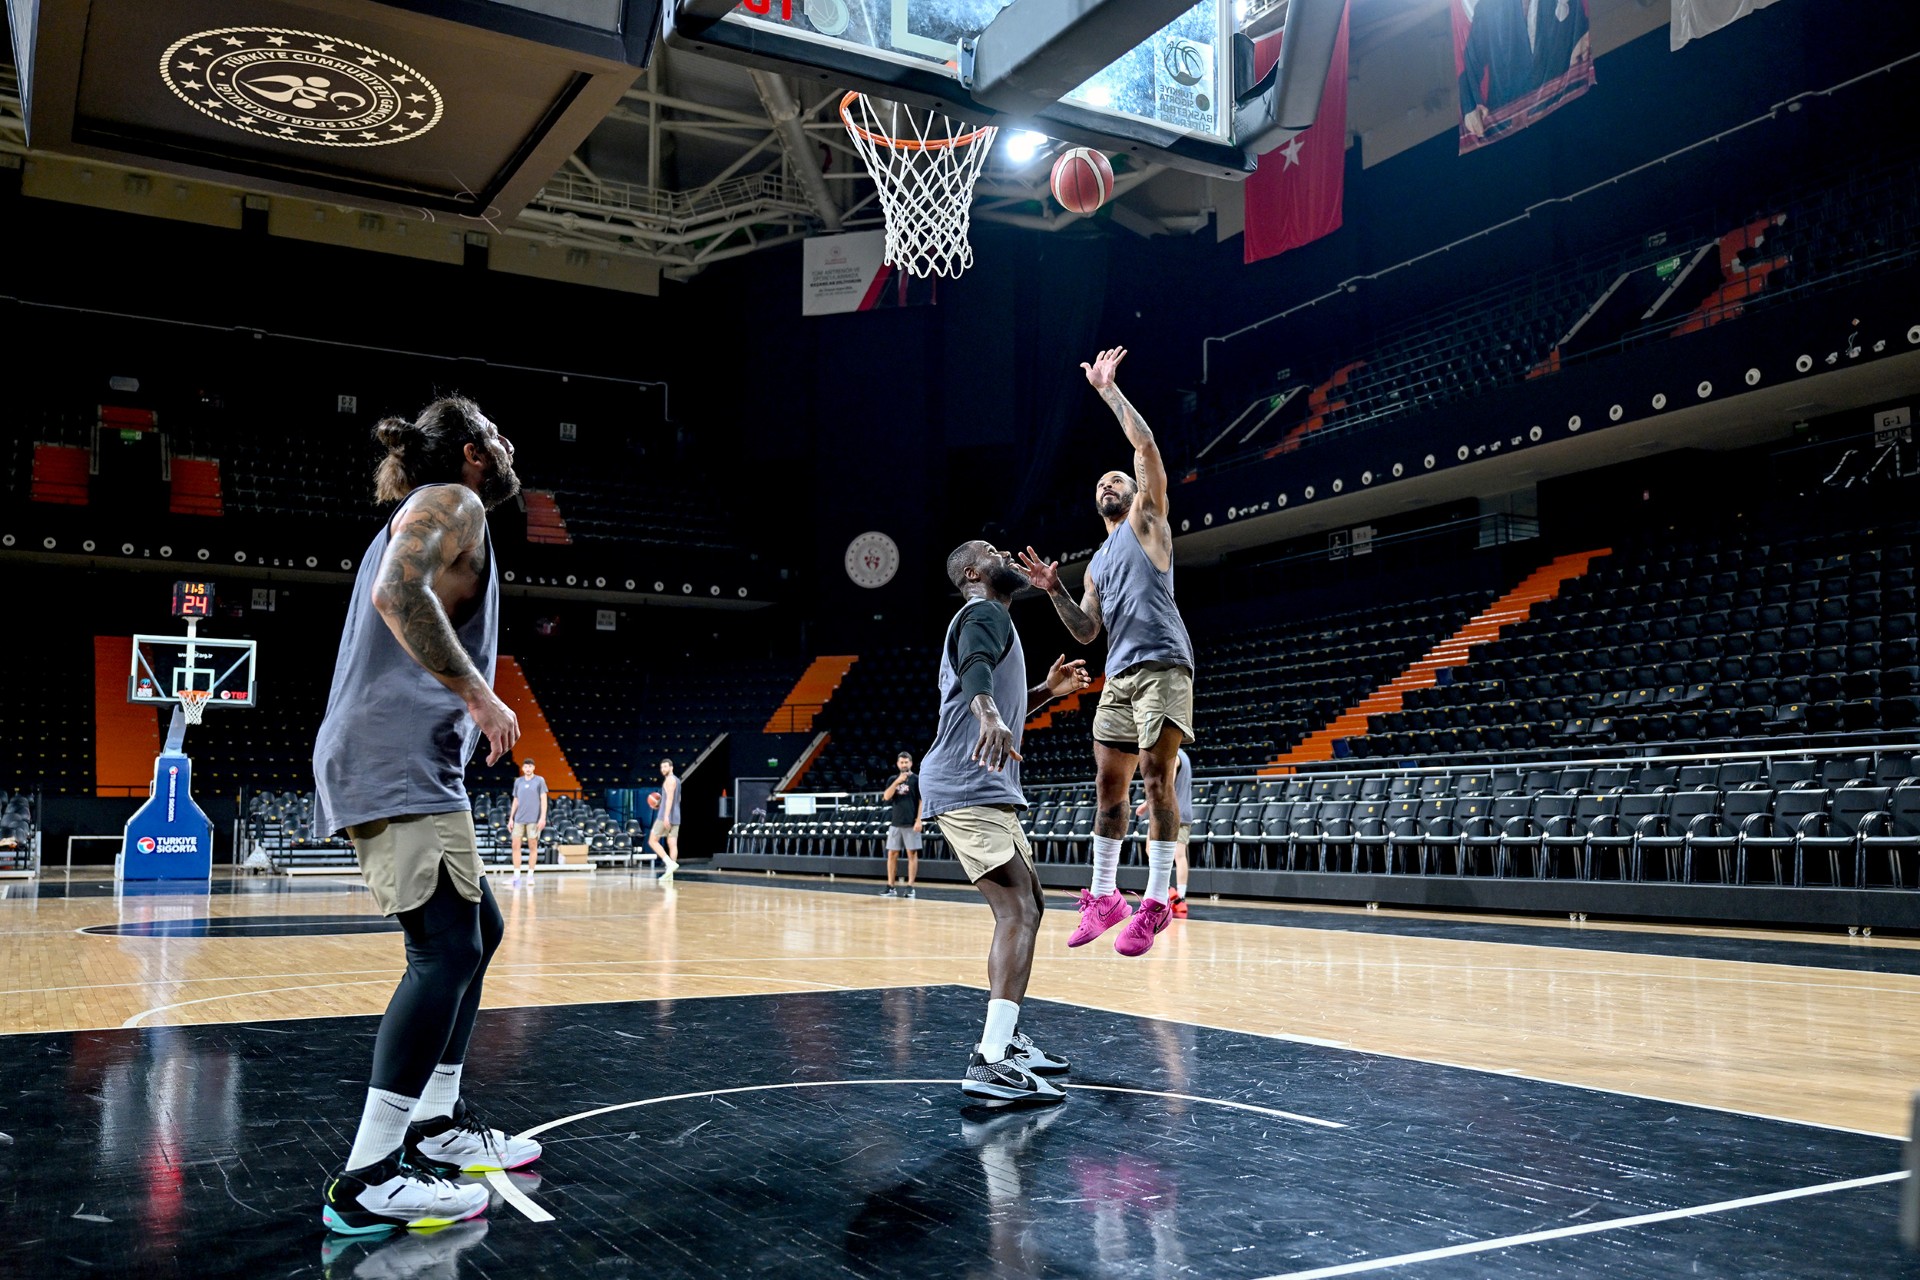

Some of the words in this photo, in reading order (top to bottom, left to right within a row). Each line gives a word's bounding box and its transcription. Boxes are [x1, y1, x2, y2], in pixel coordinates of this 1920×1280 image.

[222, 51, 289, 68] TÜRKİYE
[292, 53, 395, 98] CUMHURİYETİ
[215, 83, 287, 121] BAKANLIĞI
[358, 98, 394, 125] GENÇLİK
[291, 117, 336, 128] SPOR
[1883, 416, 1901, 427] G-1
[182, 595, 208, 614] 24
